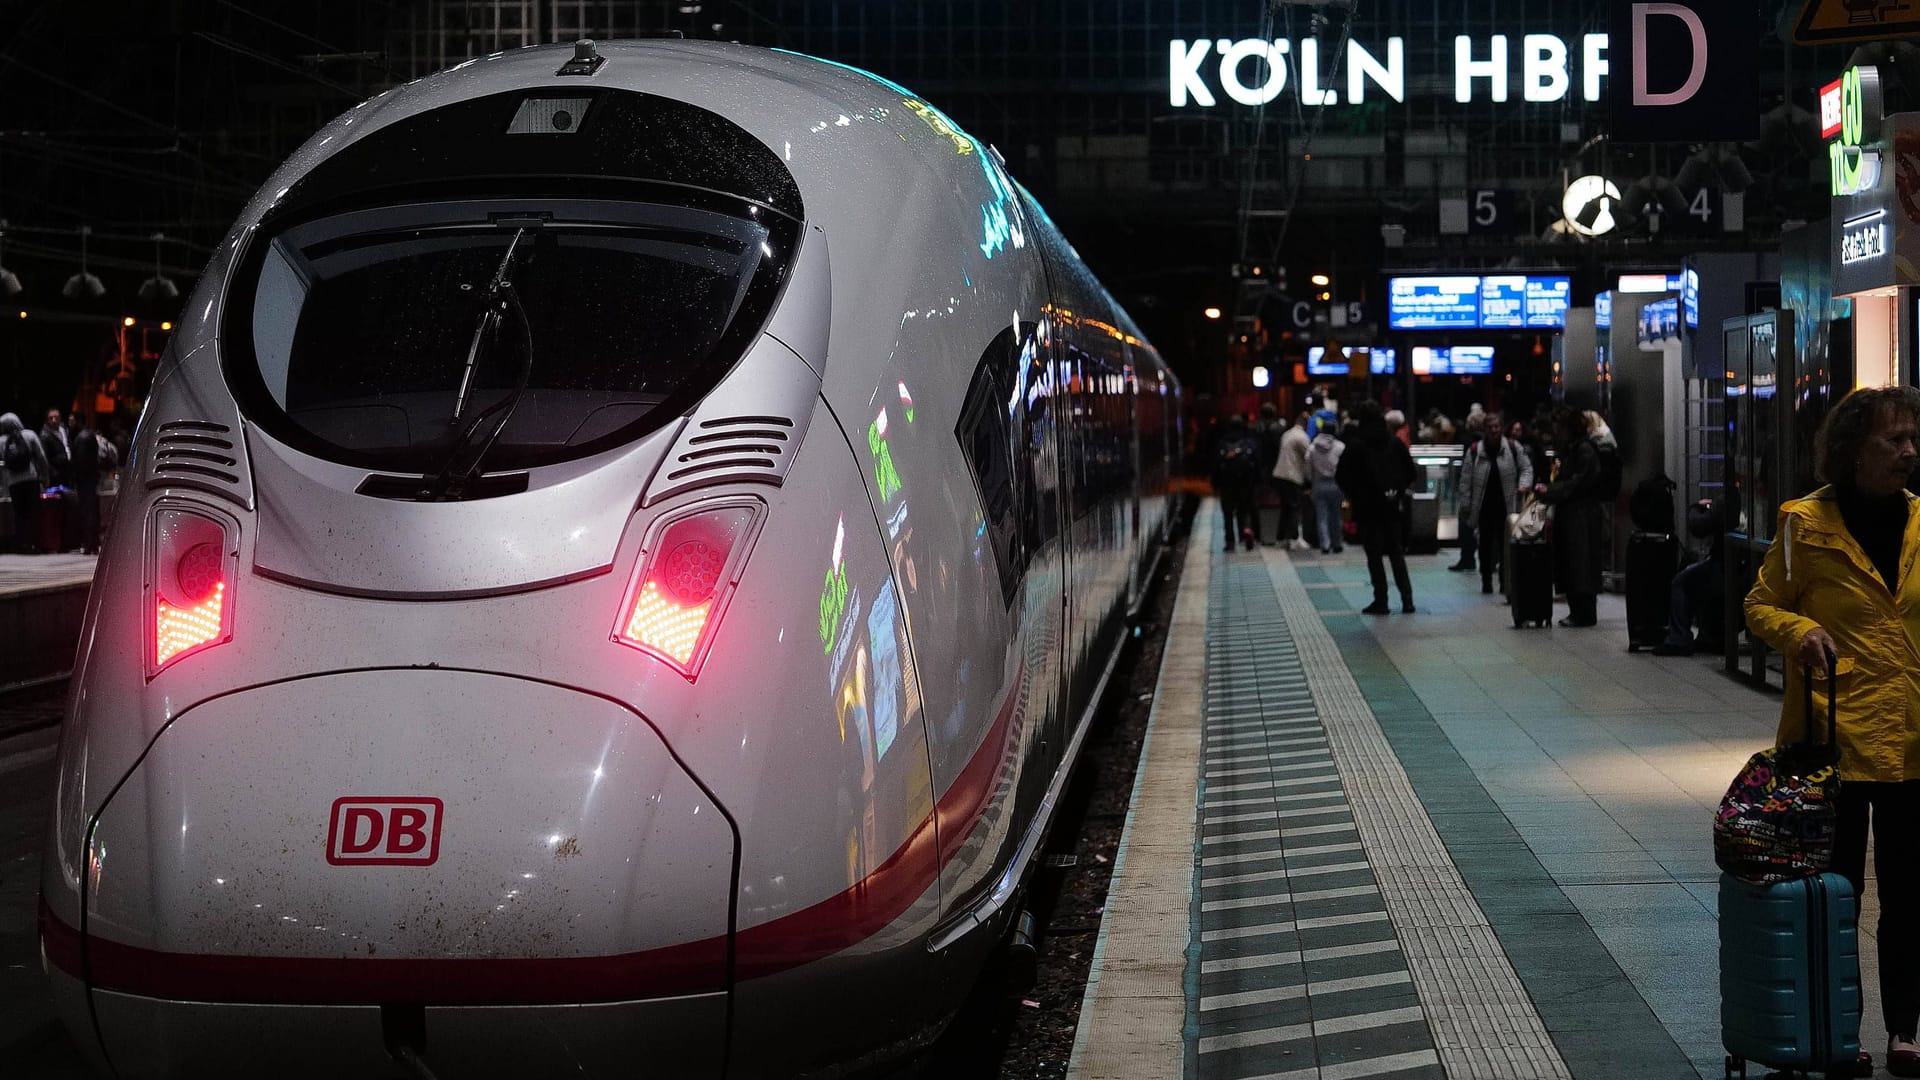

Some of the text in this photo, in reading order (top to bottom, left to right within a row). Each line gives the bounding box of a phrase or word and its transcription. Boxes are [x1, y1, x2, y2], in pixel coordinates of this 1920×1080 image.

[1169, 33, 1609, 108] KÖLN HBF
[1631, 2, 1708, 106] D
[1842, 65, 1863, 147] GO
[1829, 140, 1844, 197] TO
[1476, 191, 1497, 225] 5
[1690, 188, 1711, 222] 4
[1292, 300, 1312, 328] C
[1348, 301, 1363, 324] 5
[339, 806, 429, 855] DB
